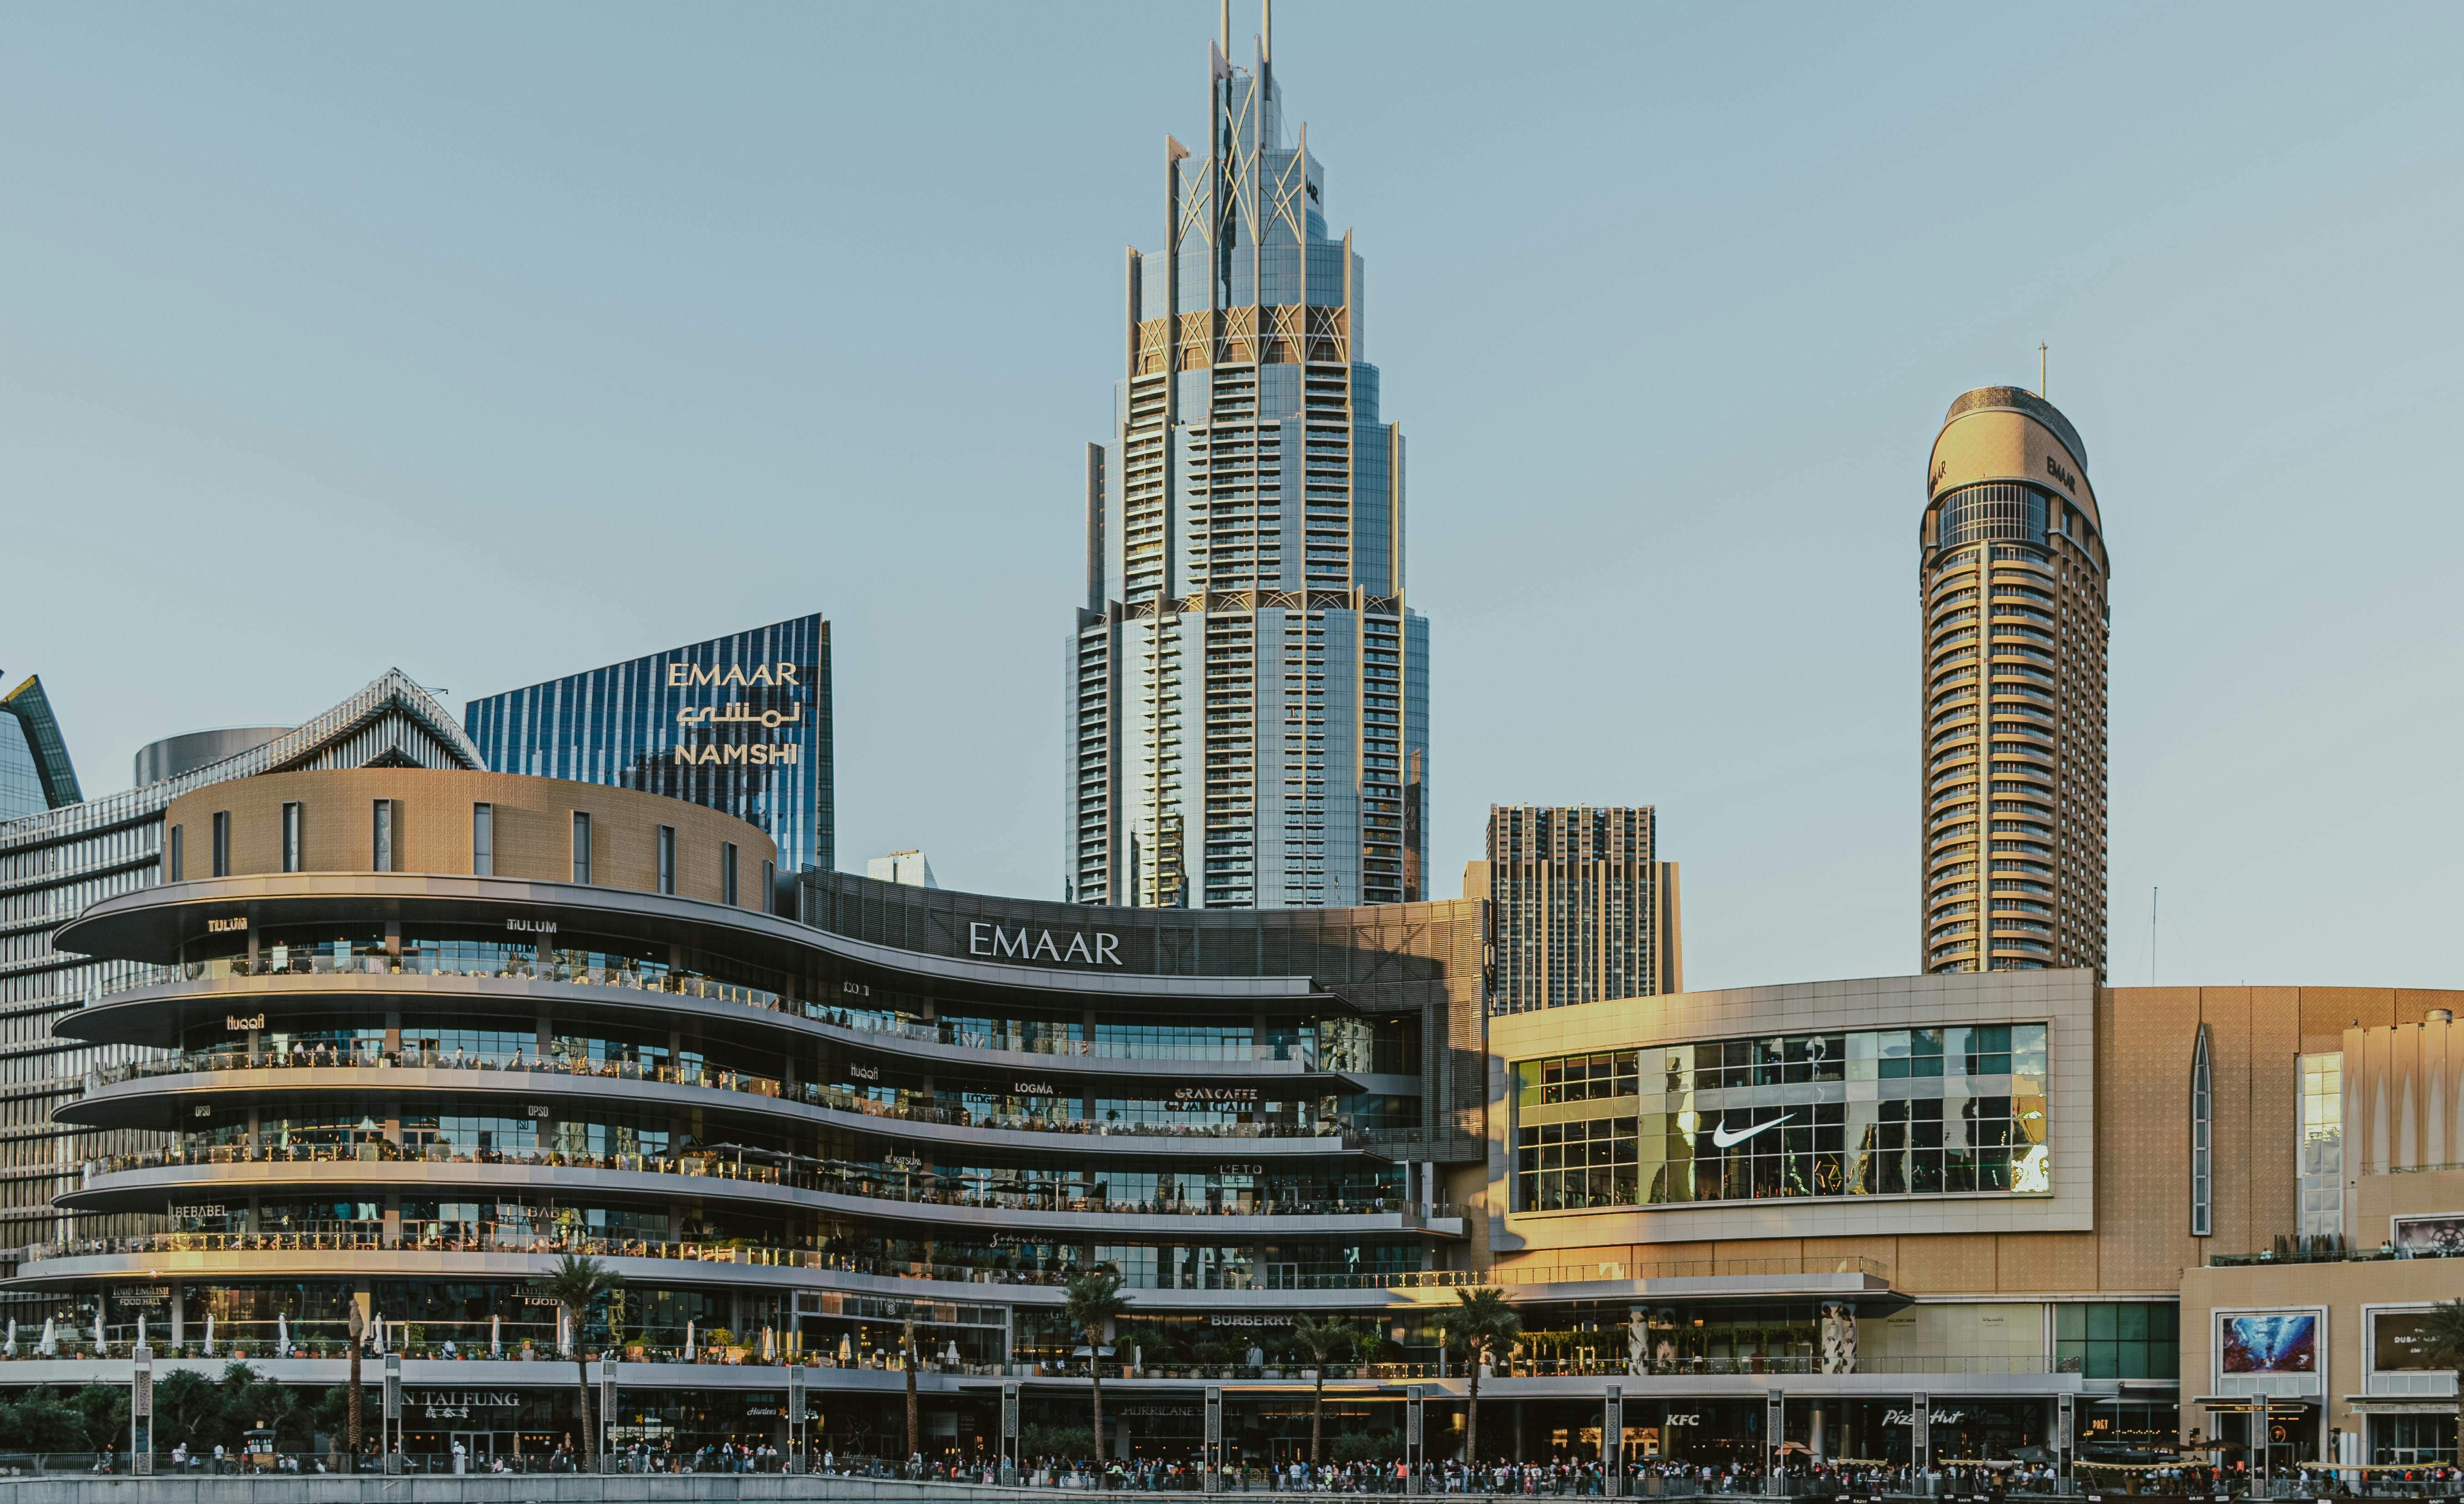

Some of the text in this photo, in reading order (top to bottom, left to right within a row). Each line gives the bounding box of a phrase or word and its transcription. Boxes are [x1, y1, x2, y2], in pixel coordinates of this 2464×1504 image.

[2047, 455, 2076, 496] EMAAR
[668, 663, 799, 686] EMAAR
[675, 744, 797, 765] NAMSHI
[507, 919, 557, 933] TULUM
[970, 921, 1123, 965] EMAAR
[1014, 1082, 1053, 1095] LOGMA
[528, 1106, 549, 1117] OPSO
[894, 1156, 922, 1166] KATSUYA
[1210, 1315, 1293, 1327] BURBERRY
[422, 1392, 457, 1406] TAI
[462, 1392, 520, 1406] FUNG
[1666, 1414, 1700, 1426] KFC
[1882, 1409, 1965, 1426] Pizz Hut
[2093, 1419, 2109, 1430] PRET
